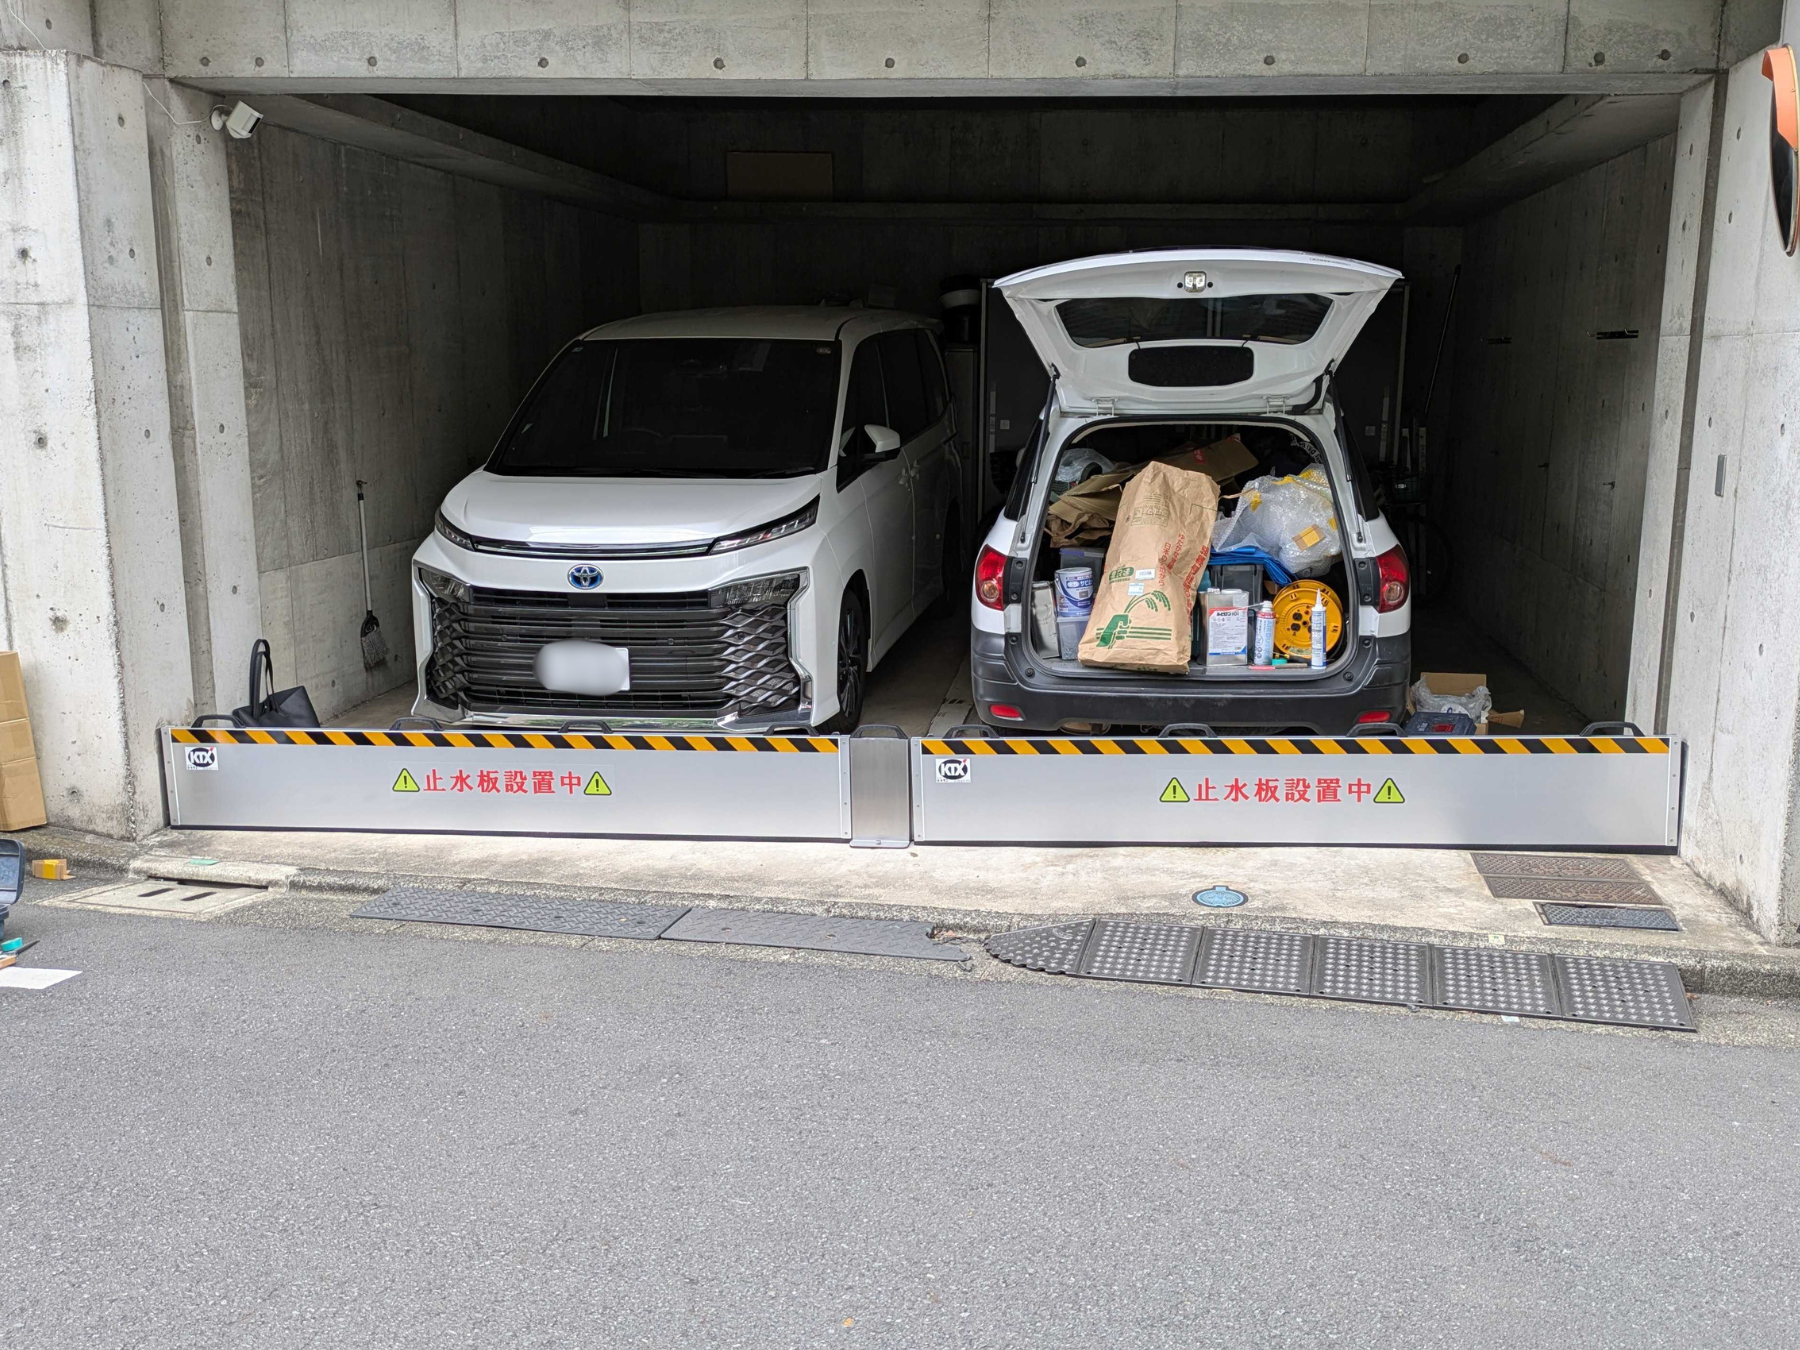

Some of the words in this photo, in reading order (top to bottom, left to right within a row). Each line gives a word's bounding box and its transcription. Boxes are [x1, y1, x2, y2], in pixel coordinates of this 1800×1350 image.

[189, 747, 214, 765] KTX
[940, 759, 967, 777] KTX
[424, 769, 582, 795] 止水板設置中
[1194, 777, 1372, 804] 止水板設置中
